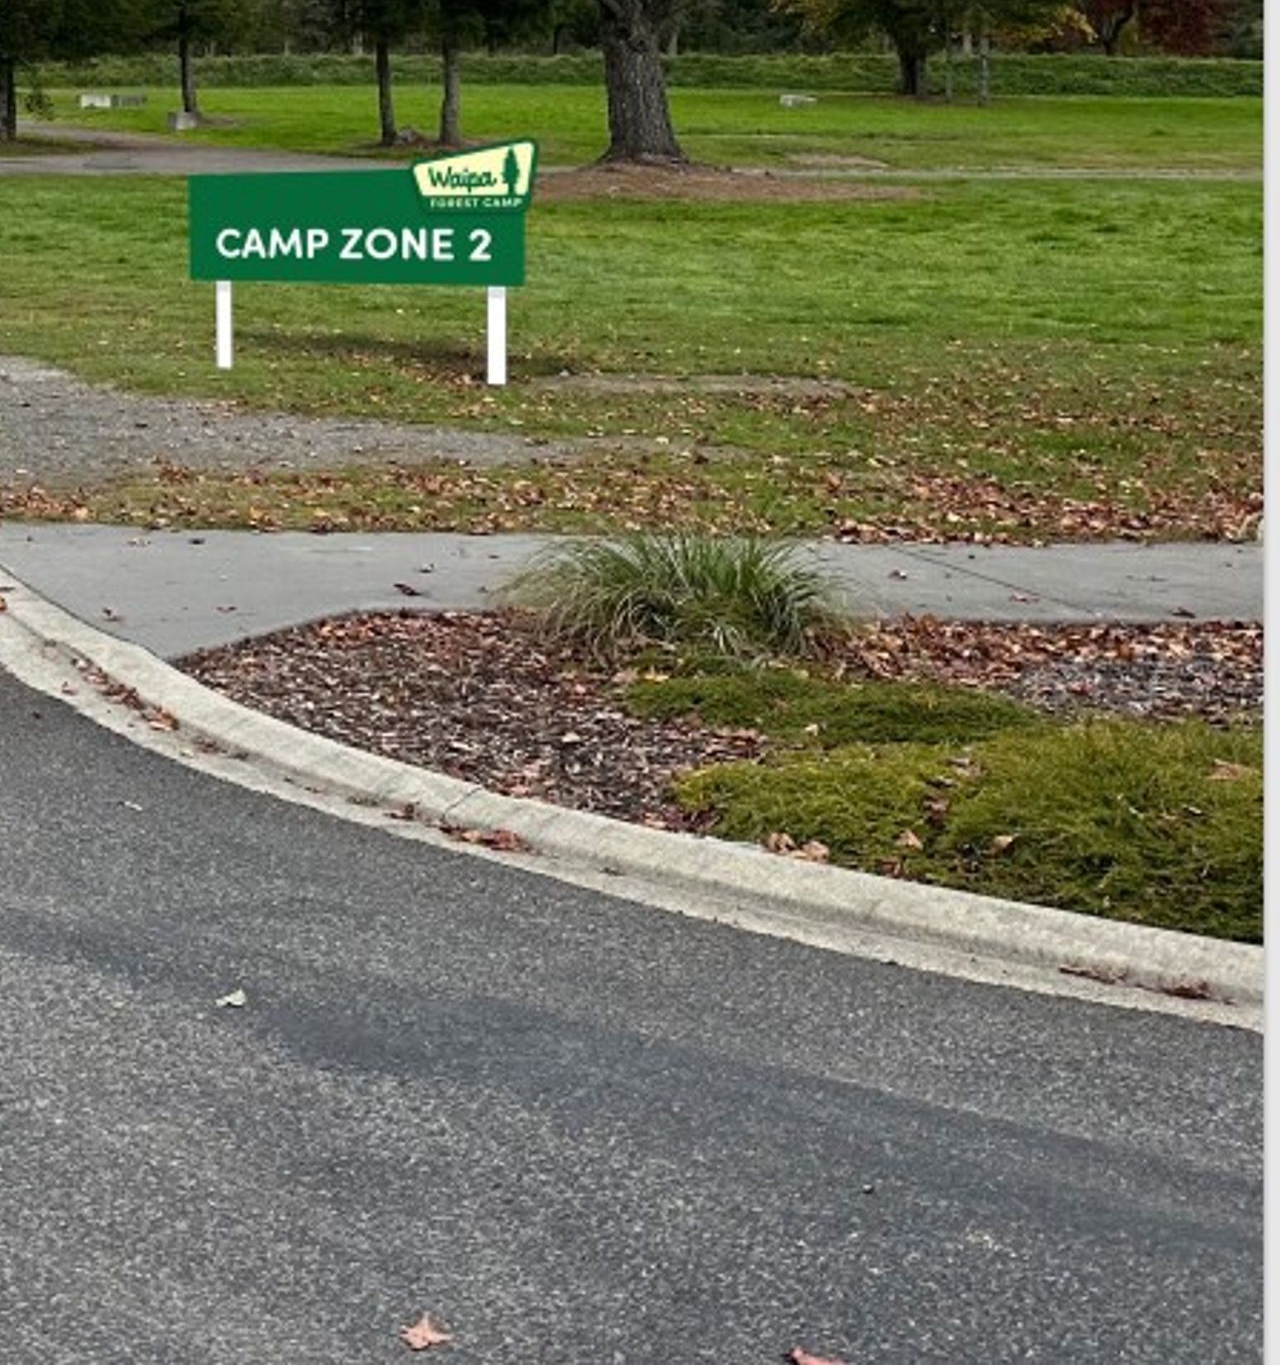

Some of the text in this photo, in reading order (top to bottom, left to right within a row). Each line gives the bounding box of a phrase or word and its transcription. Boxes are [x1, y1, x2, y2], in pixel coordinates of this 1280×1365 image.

[428, 166, 497, 193] Waipa
[430, 197, 524, 208] FOREST CAMP
[215, 228, 493, 262] CAMP ZONE 2
